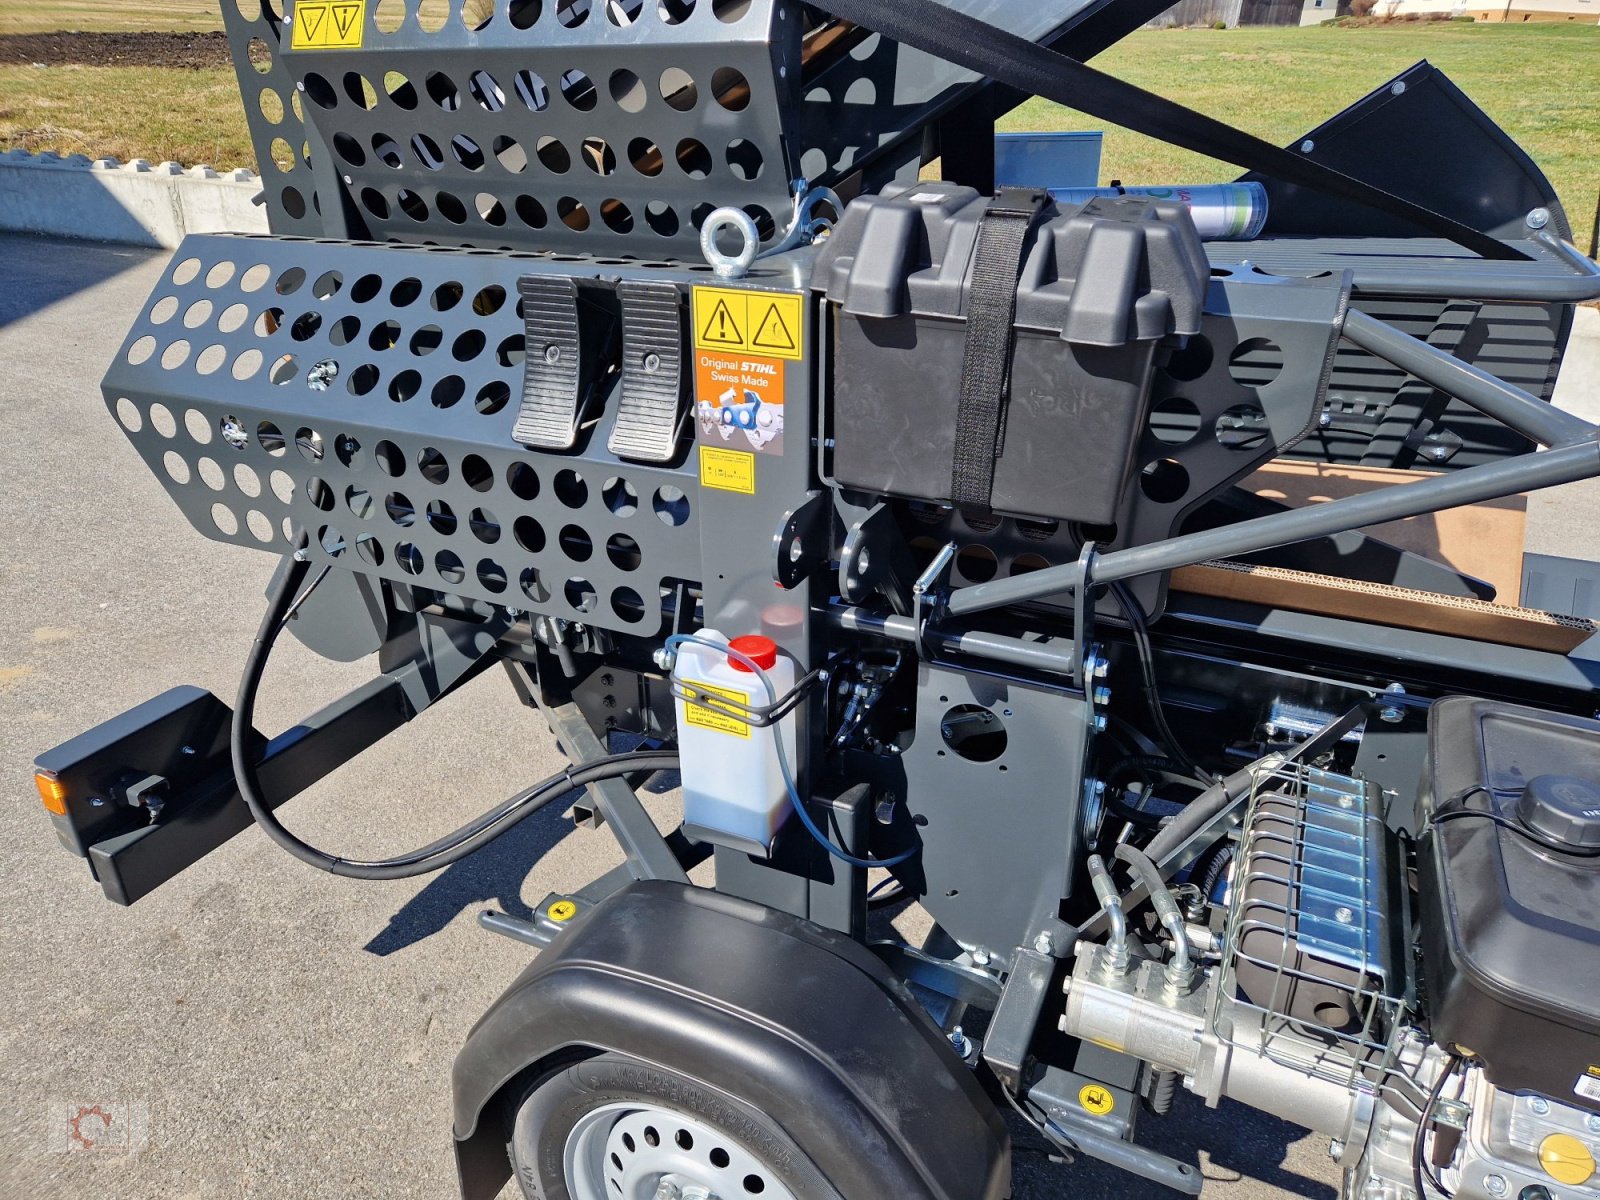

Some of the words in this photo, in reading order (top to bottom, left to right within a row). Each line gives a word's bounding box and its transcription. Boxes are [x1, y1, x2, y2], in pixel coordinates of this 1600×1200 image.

[701, 357, 738, 370] Original
[740, 362, 777, 375] STIHL
[711, 371, 739, 383] Swiss
[741, 375, 769, 387] Made
